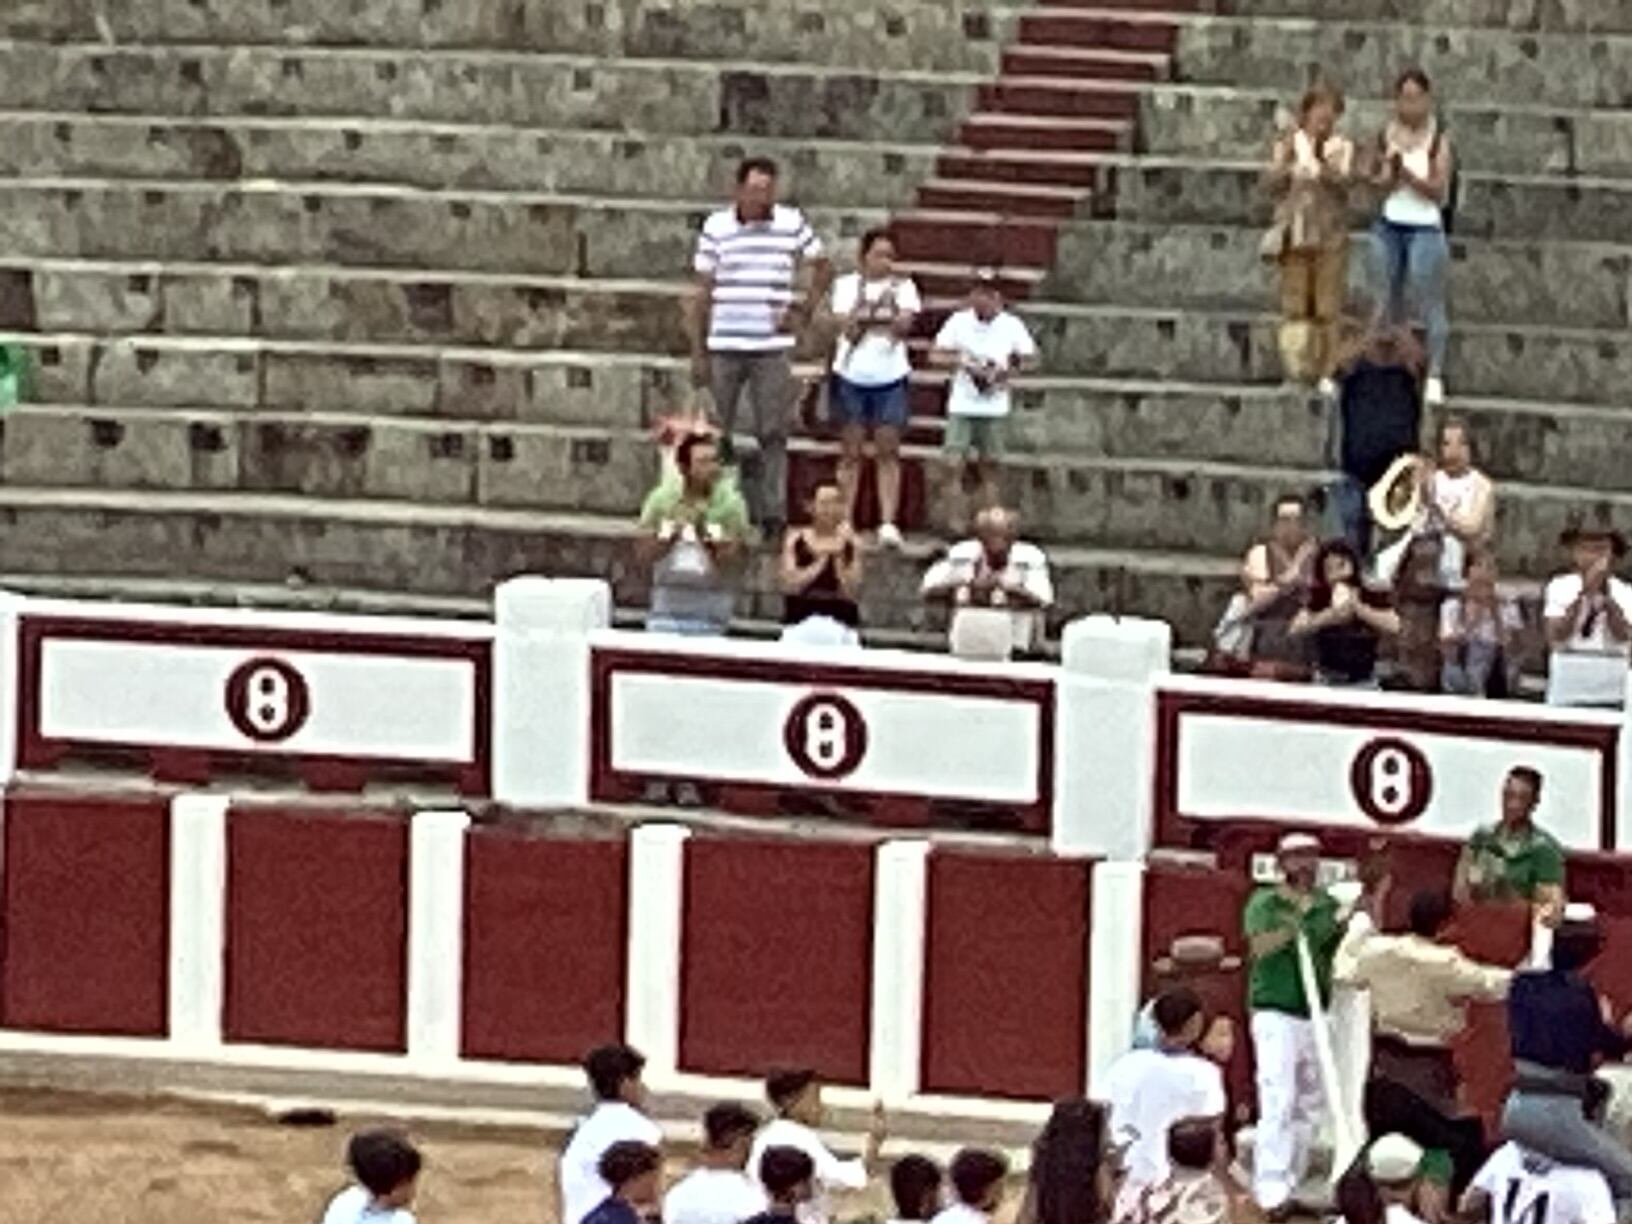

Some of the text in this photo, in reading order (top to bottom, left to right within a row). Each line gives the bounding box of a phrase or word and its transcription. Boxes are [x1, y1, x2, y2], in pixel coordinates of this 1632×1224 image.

[248, 668, 288, 732] 8
[806, 703, 845, 770] 8
[1372, 749, 1410, 813] 8
